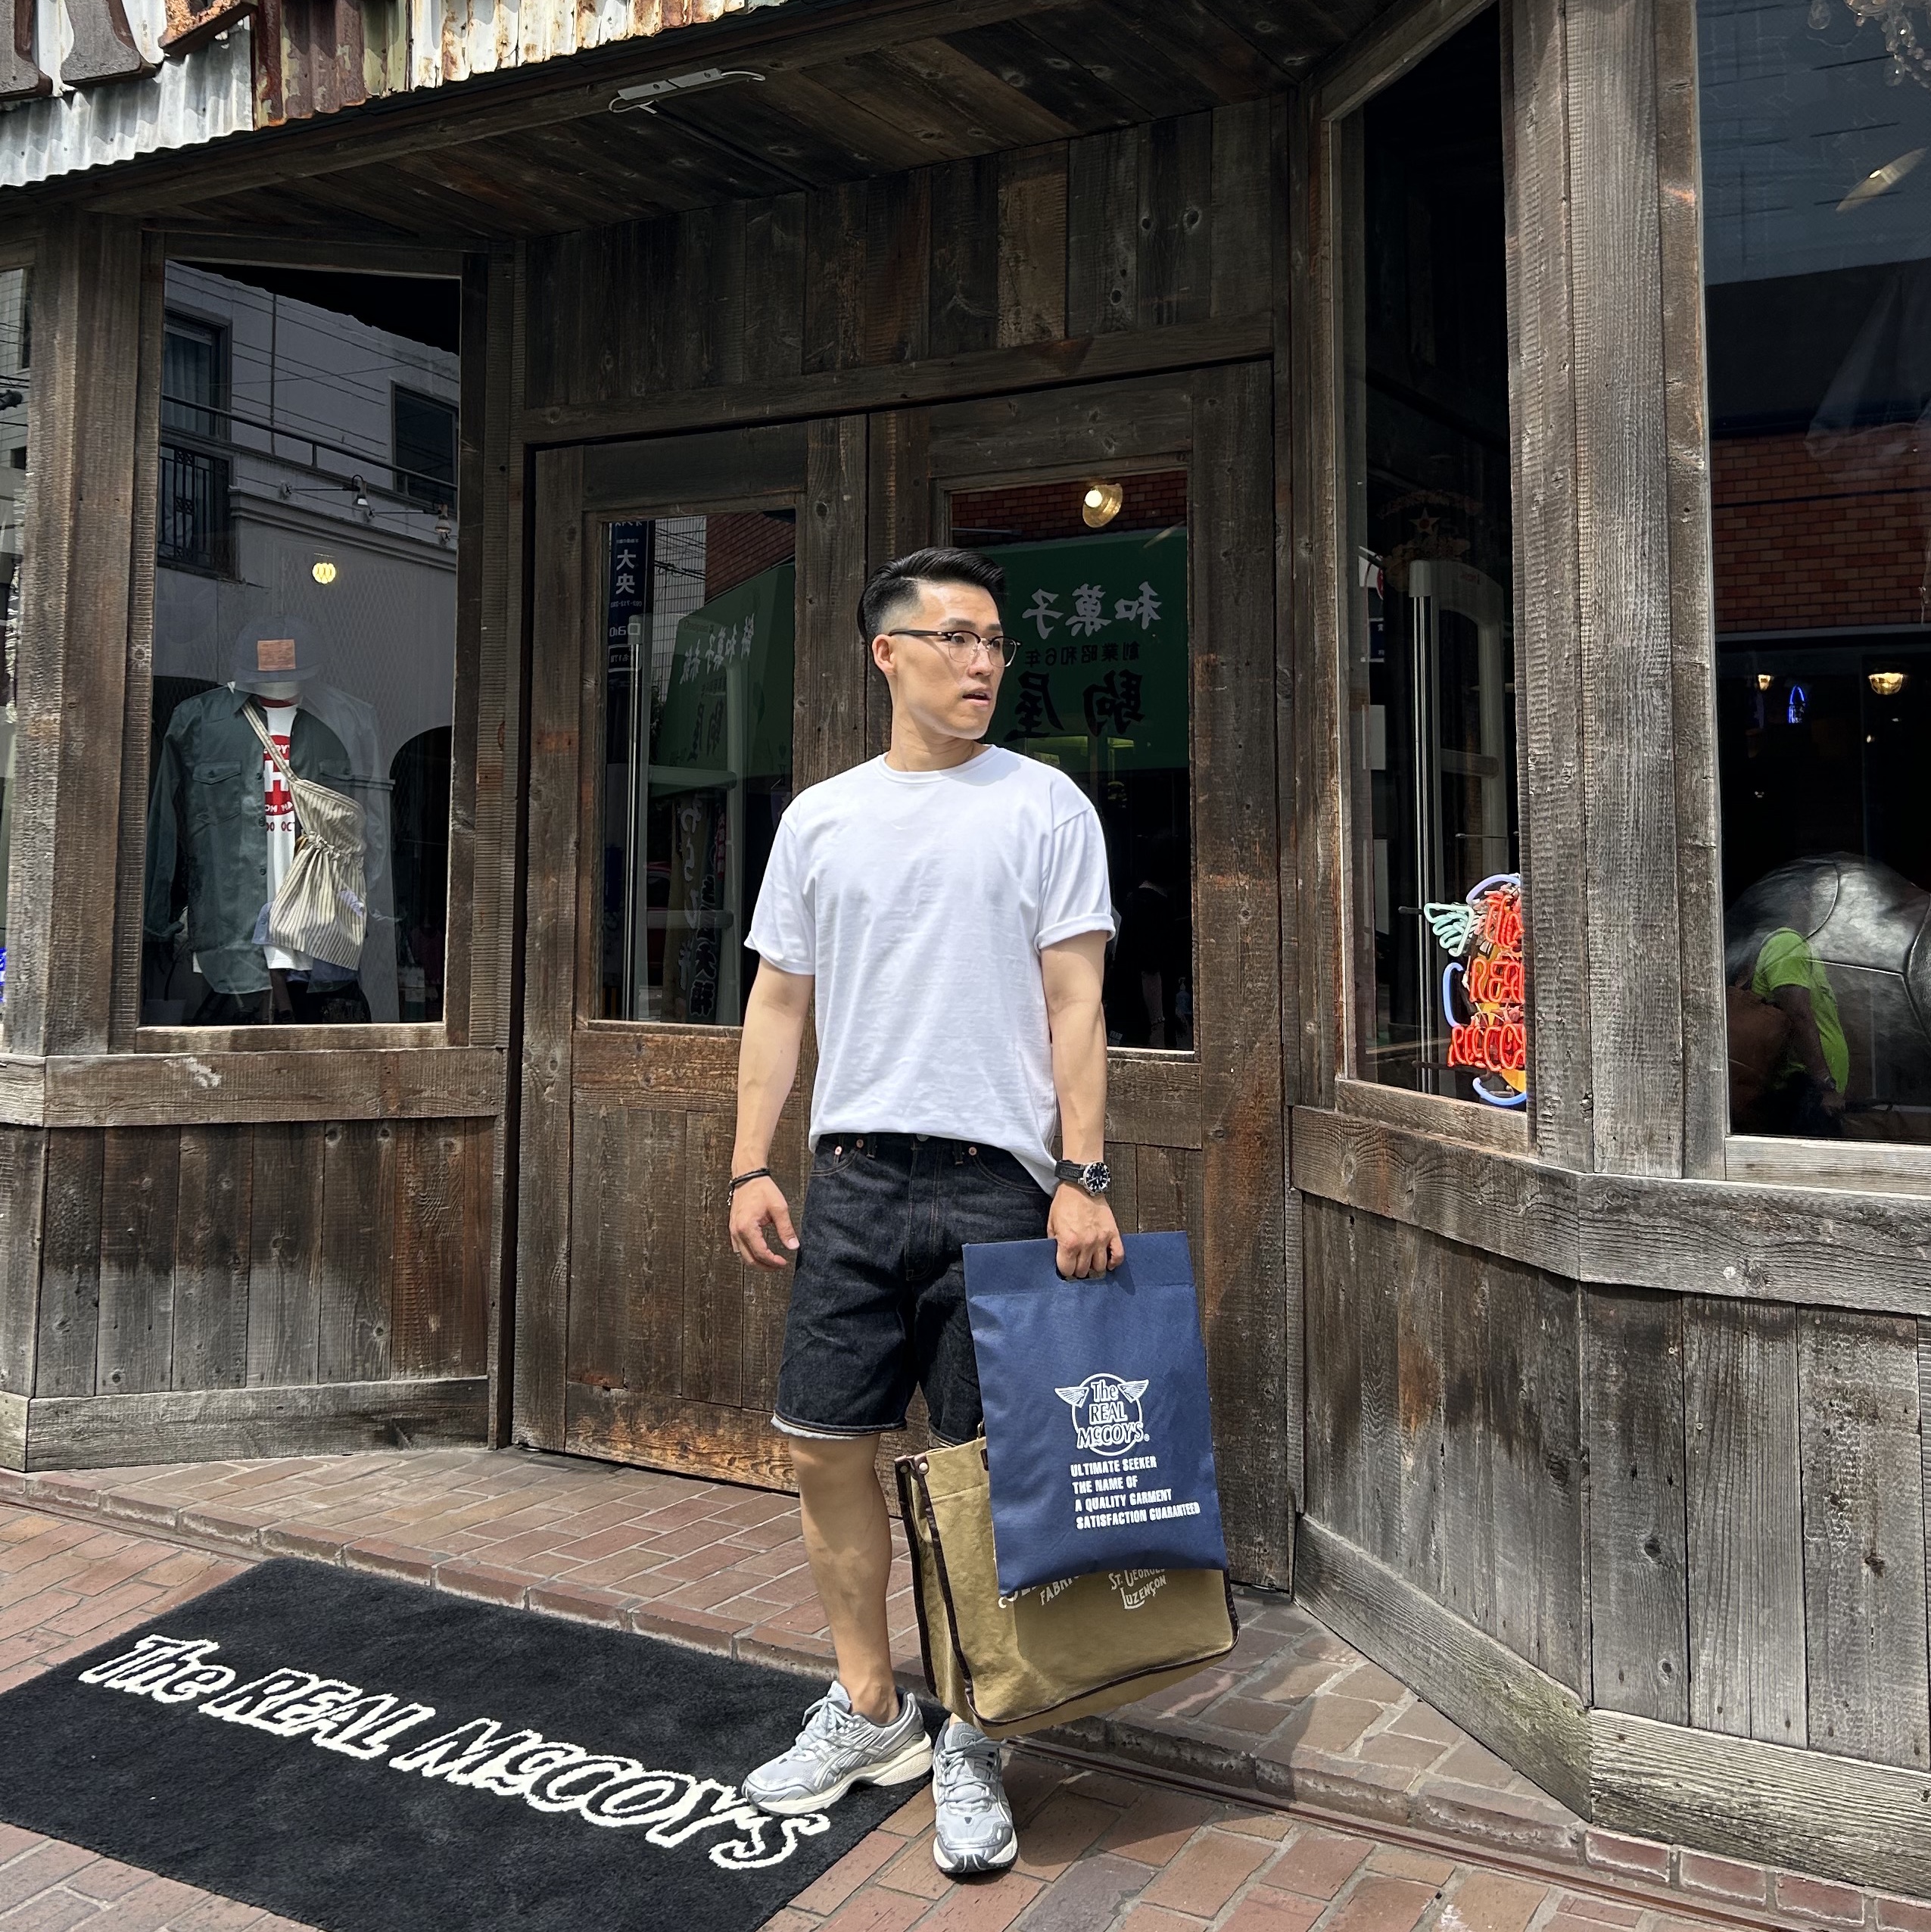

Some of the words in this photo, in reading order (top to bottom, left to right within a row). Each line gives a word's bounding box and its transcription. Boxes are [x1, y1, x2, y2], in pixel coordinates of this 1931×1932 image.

[1469, 958, 1525, 1003] REA
[1091, 1379, 1119, 1402] The
[1089, 1401, 1128, 1425] REAL
[1070, 1460, 1120, 1477] ULTIMATE
[1123, 1456, 1157, 1471] SEEKER
[1072, 1480, 1092, 1494] THE
[1095, 1477, 1123, 1492] NAME
[1126, 1475, 1138, 1488] OF
[1075, 1499, 1082, 1512] A
[1085, 1494, 1126, 1513] QUALITY
[1129, 1488, 1172, 1506] GARMENT
[1076, 1510, 1148, 1529] SATISFACTION
[1149, 1501, 1201, 1521] GUARANTEED
[78, 1633, 236, 1703] The
[198, 1667, 437, 1760] REAL
